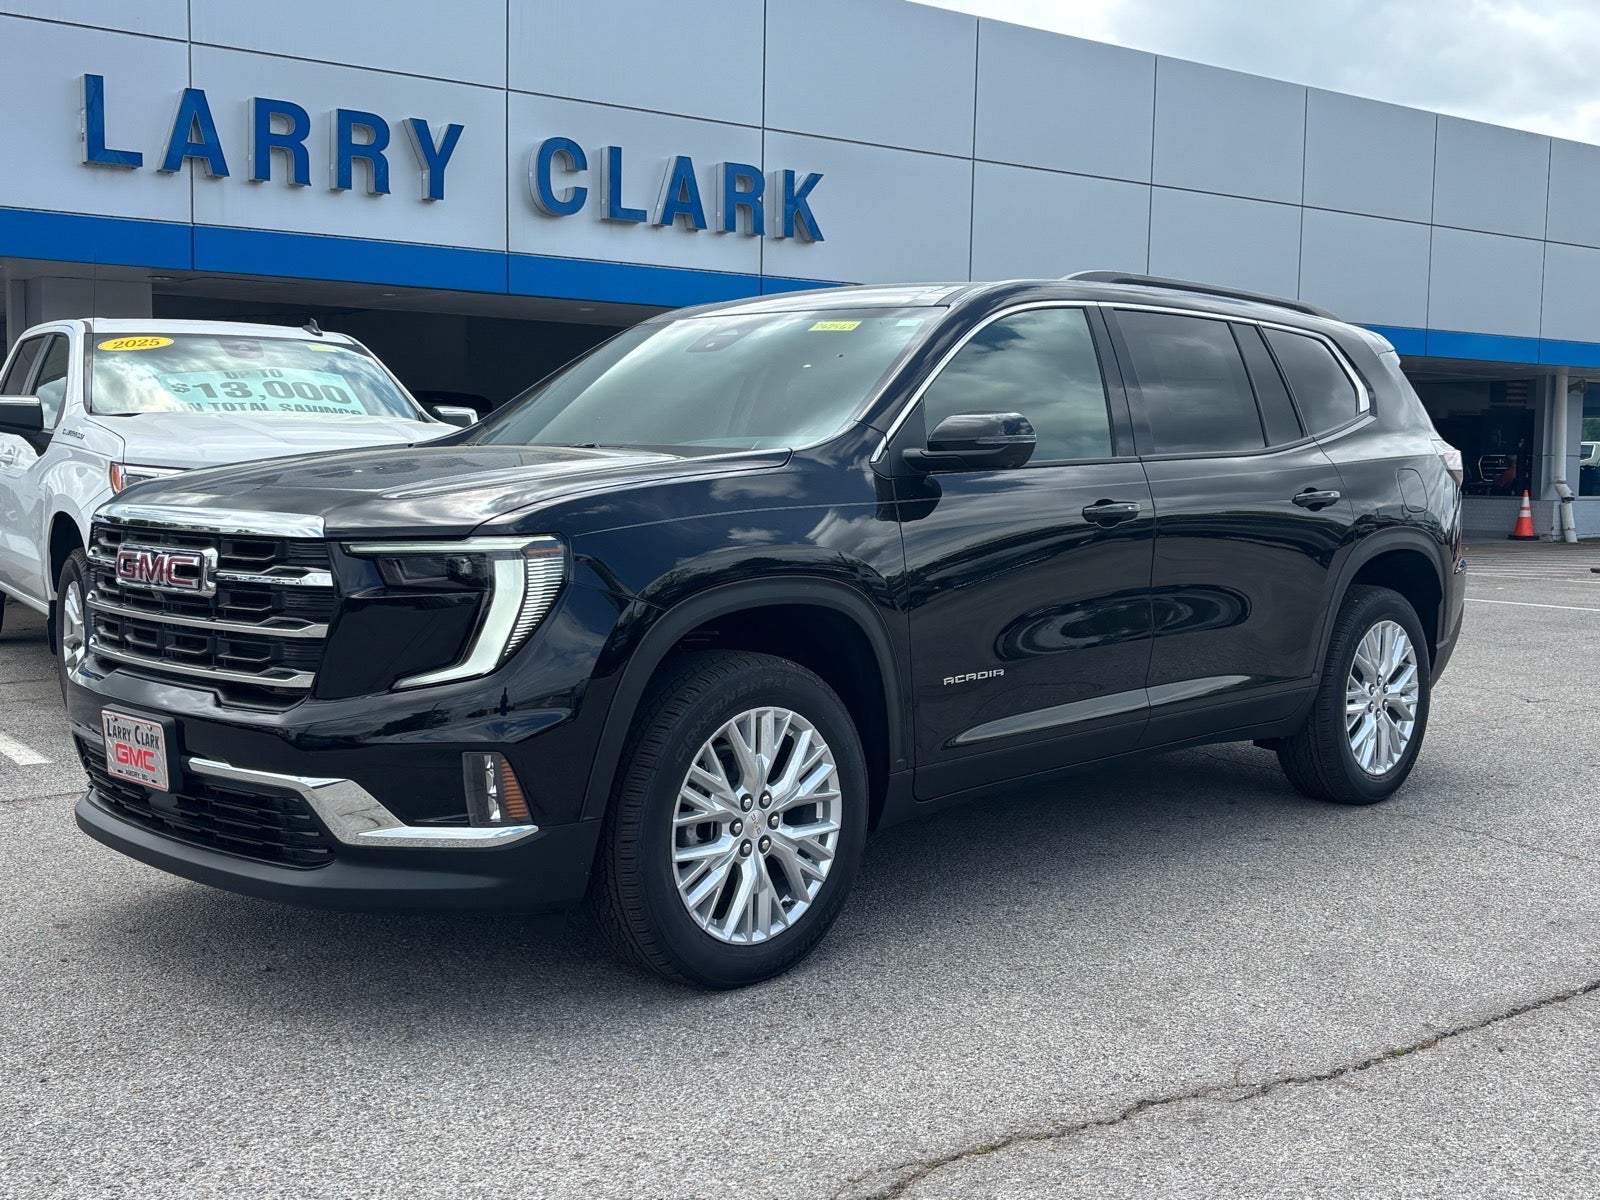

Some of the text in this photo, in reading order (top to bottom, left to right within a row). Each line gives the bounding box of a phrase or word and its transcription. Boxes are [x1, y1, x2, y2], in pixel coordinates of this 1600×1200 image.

[80, 73, 824, 243] LARRY CLARK
[112, 338, 160, 349] 2025
[224, 369, 284, 379] UP TO
[171, 380, 352, 404] $13,000
[208, 402, 271, 412] TOTAL
[117, 551, 200, 588] GMC
[943, 668, 1005, 686] ACADIA
[115, 742, 156, 773] GMC
